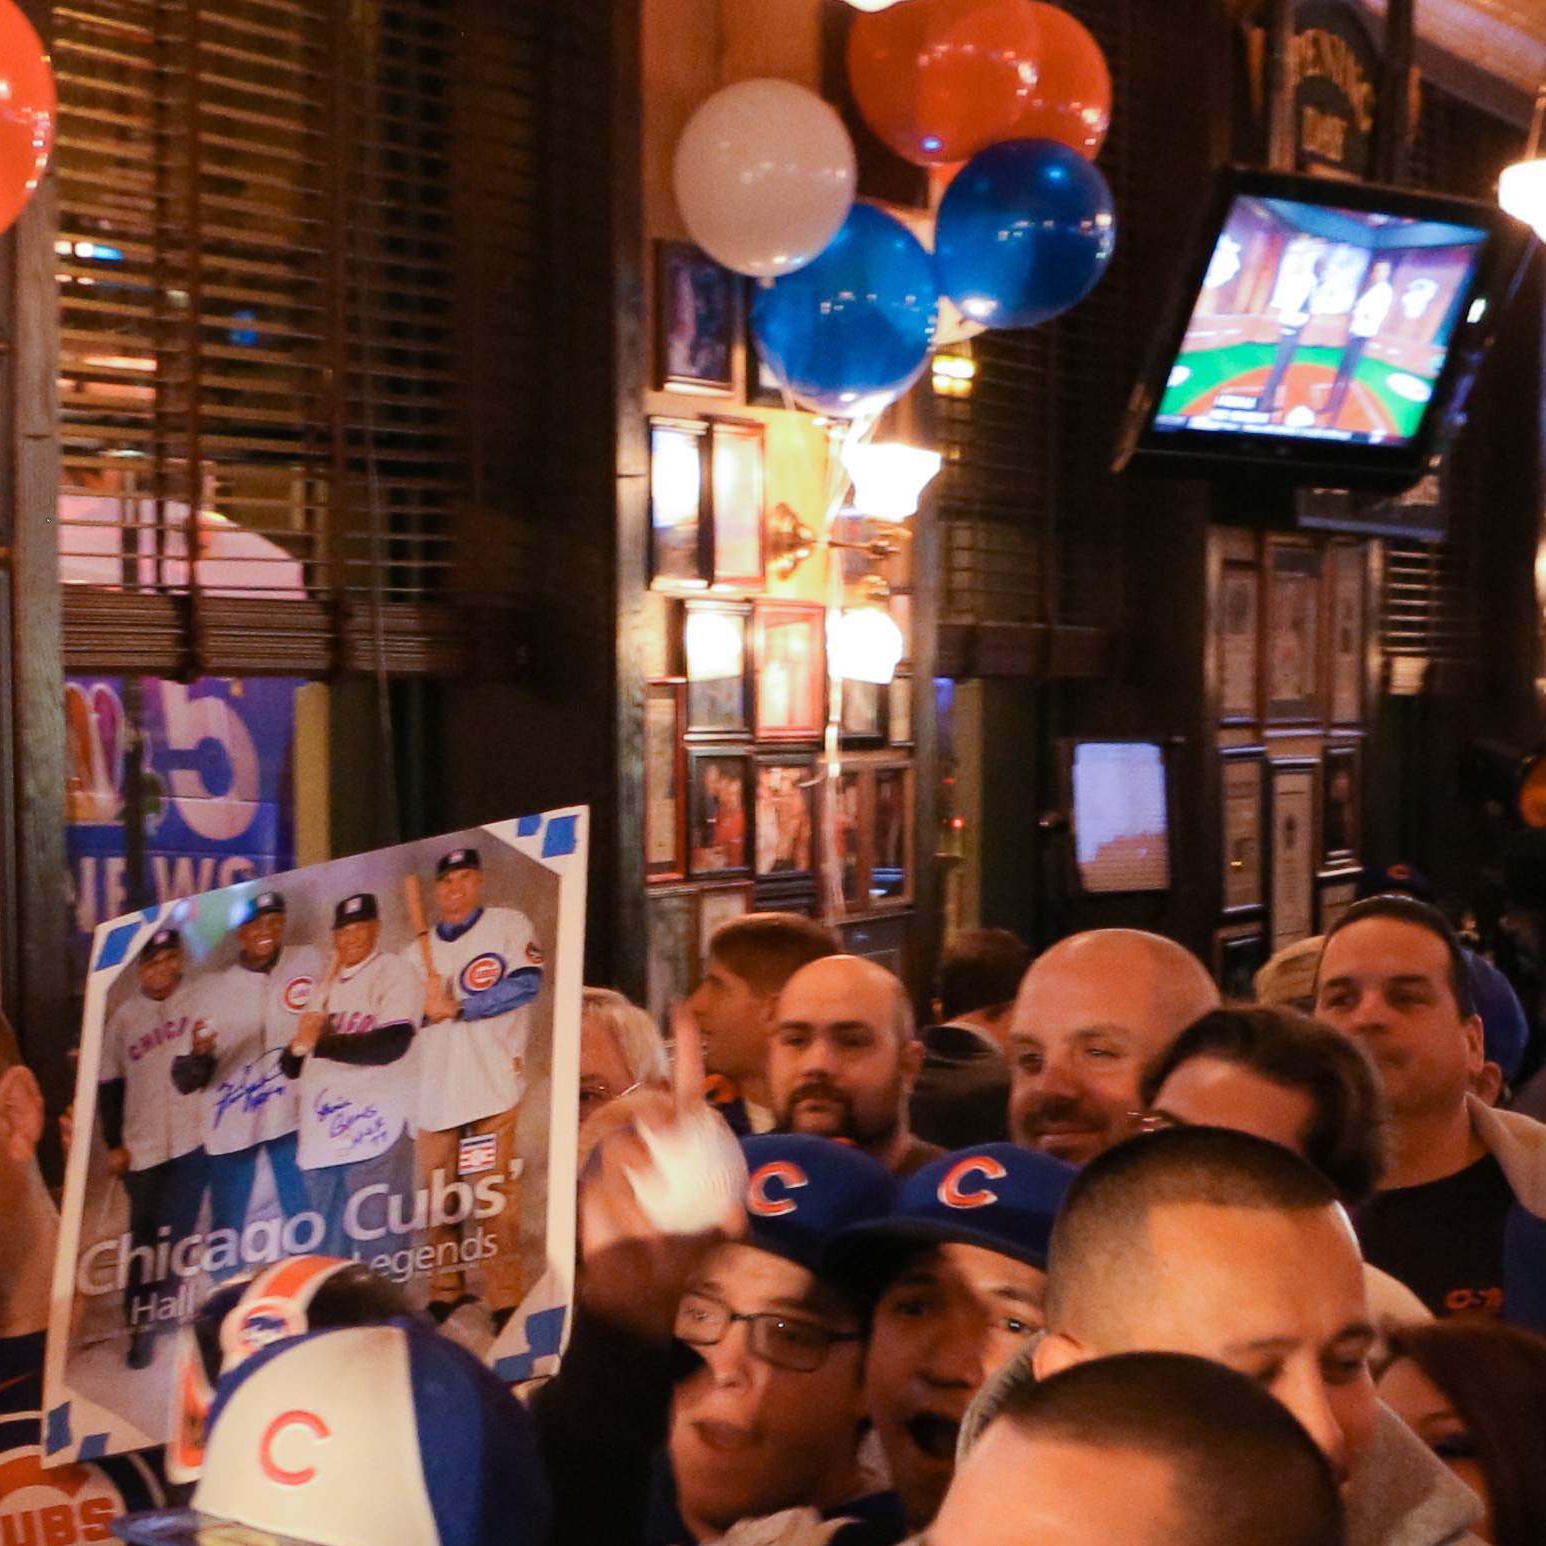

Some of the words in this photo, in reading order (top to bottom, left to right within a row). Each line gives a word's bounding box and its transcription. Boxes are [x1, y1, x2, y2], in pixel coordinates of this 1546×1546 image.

[747, 1160, 808, 1217] C
[937, 1155, 1007, 1209] C
[76, 1209, 327, 1297] Chicago
[344, 1157, 524, 1243] Cubs'
[130, 1281, 196, 1327] Hall
[354, 1228, 500, 1284] egends
[258, 1409, 331, 1487] C
